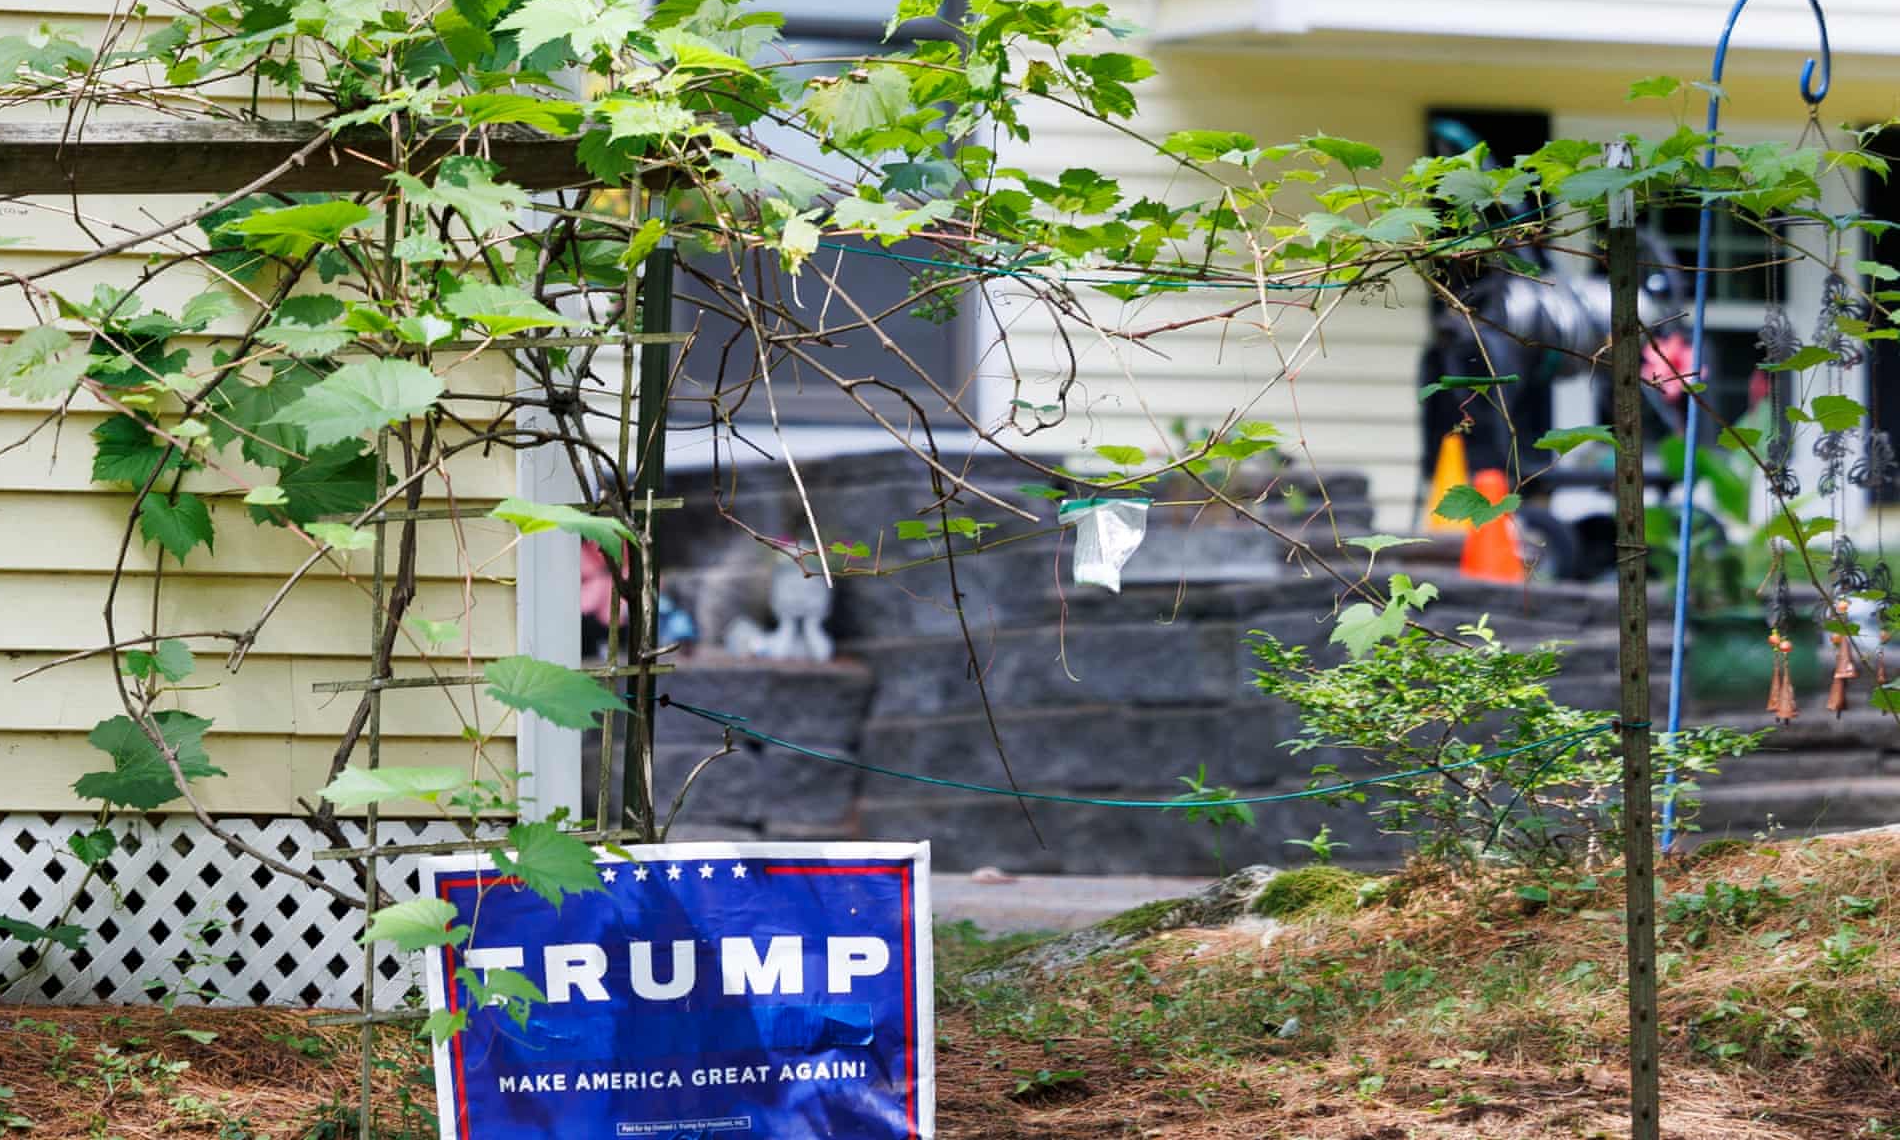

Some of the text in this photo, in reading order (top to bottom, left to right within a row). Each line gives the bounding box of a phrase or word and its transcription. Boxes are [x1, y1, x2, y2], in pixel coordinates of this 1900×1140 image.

[464, 935, 890, 1007] TRUMP
[499, 1060, 867, 1093] MAKE AMERICA GREAT AGAIN!
